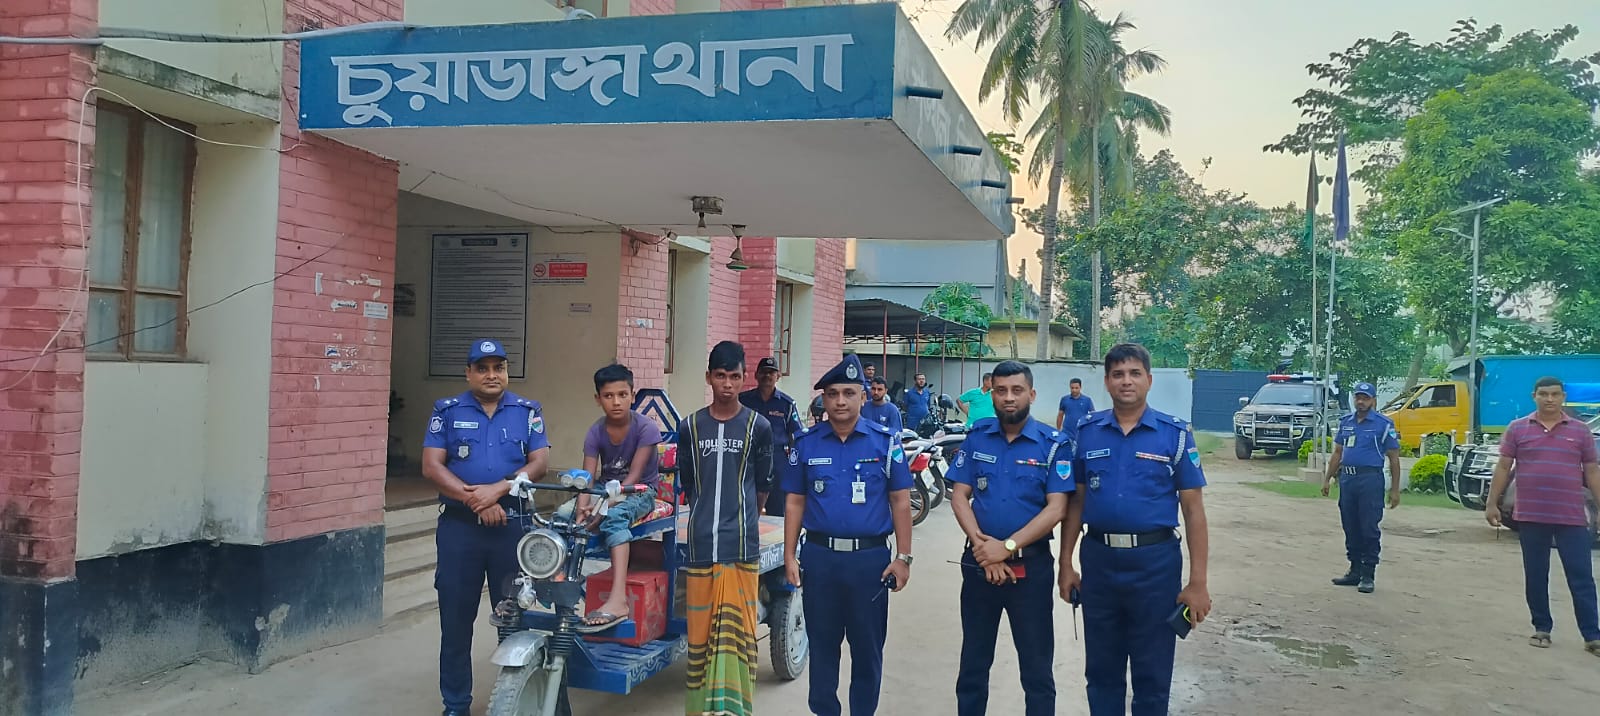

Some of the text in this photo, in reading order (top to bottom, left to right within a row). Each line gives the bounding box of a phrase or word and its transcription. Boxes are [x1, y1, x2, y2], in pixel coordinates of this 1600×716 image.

[331, 34, 854, 125] চুয়াডাঙ্গা থানা
[698, 438, 744, 449] HOLLSTER
[702, 447, 740, 457] Calrnia
